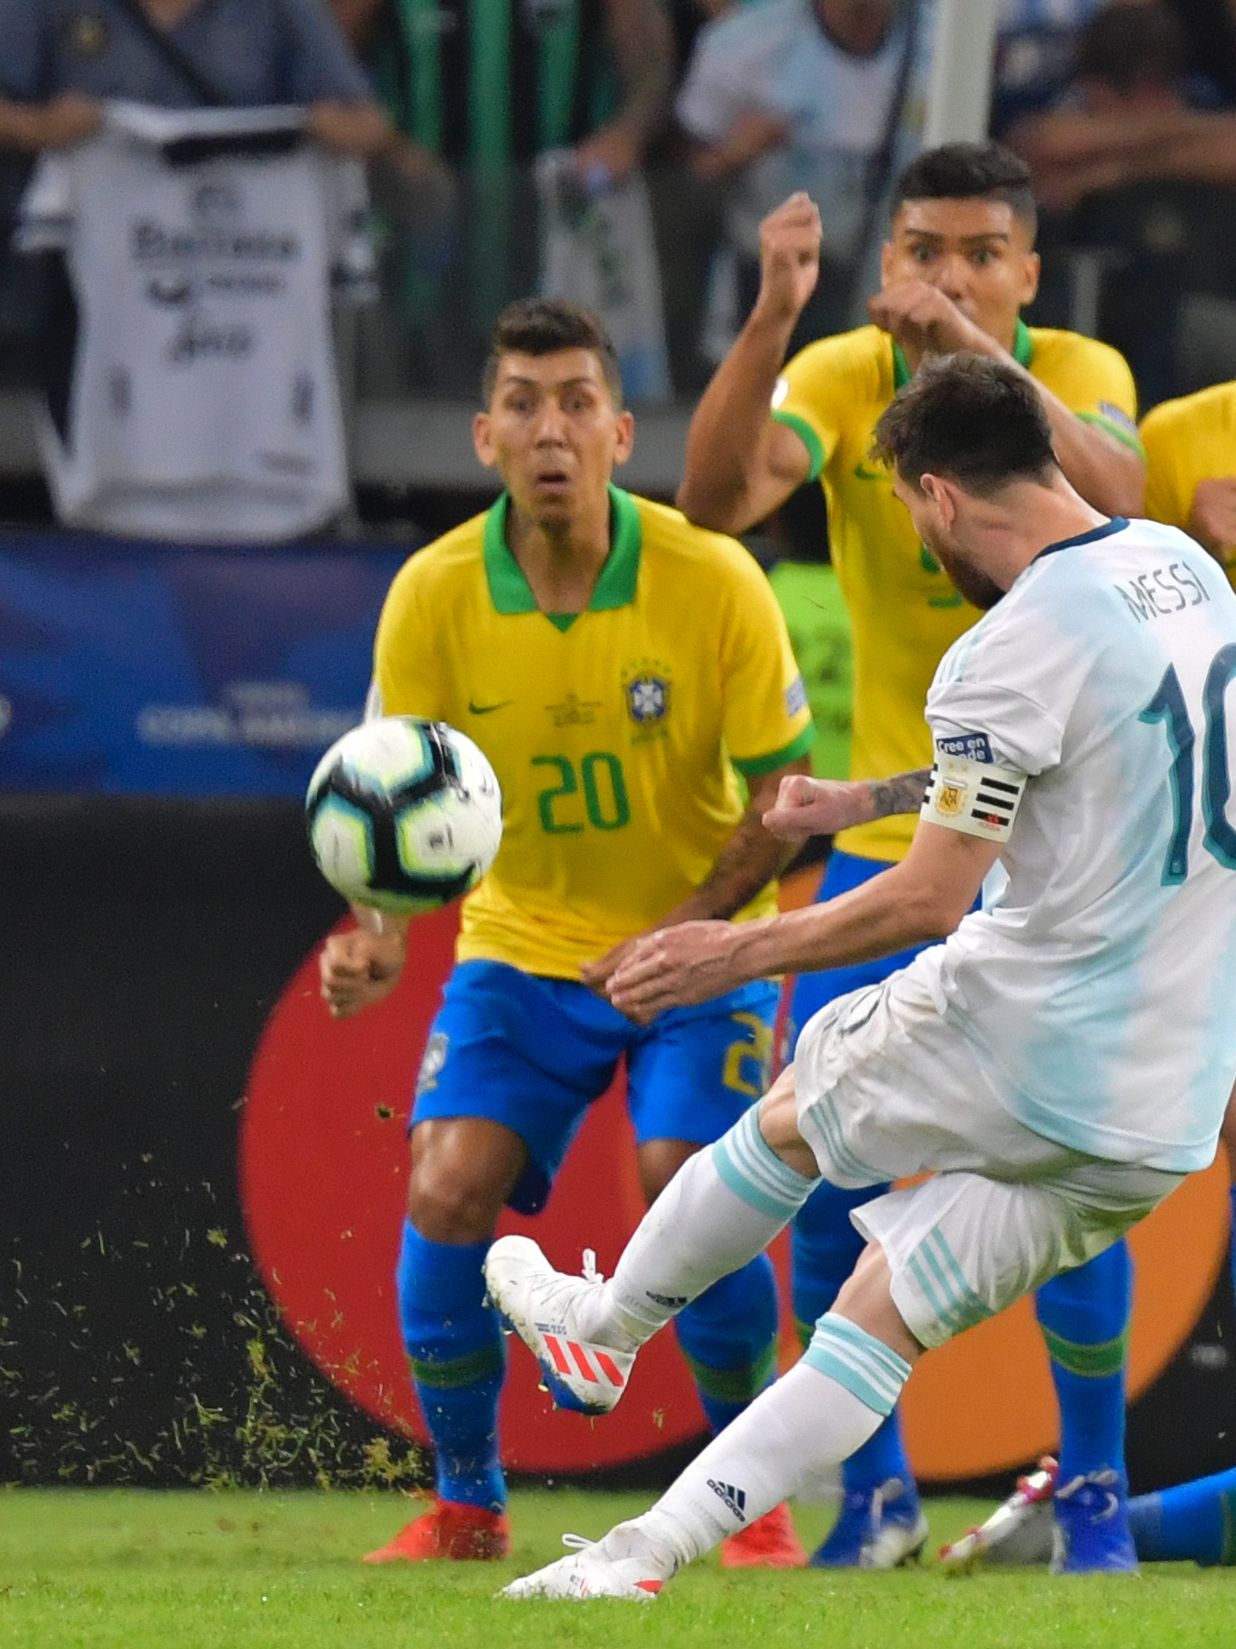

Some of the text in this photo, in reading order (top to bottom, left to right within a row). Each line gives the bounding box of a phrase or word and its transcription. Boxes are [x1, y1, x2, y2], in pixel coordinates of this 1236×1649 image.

[1113, 560, 1211, 623] MESSI
[967, 737, 986, 750] en
[531, 752, 631, 833] 20
[722, 1010, 774, 1097] 2
